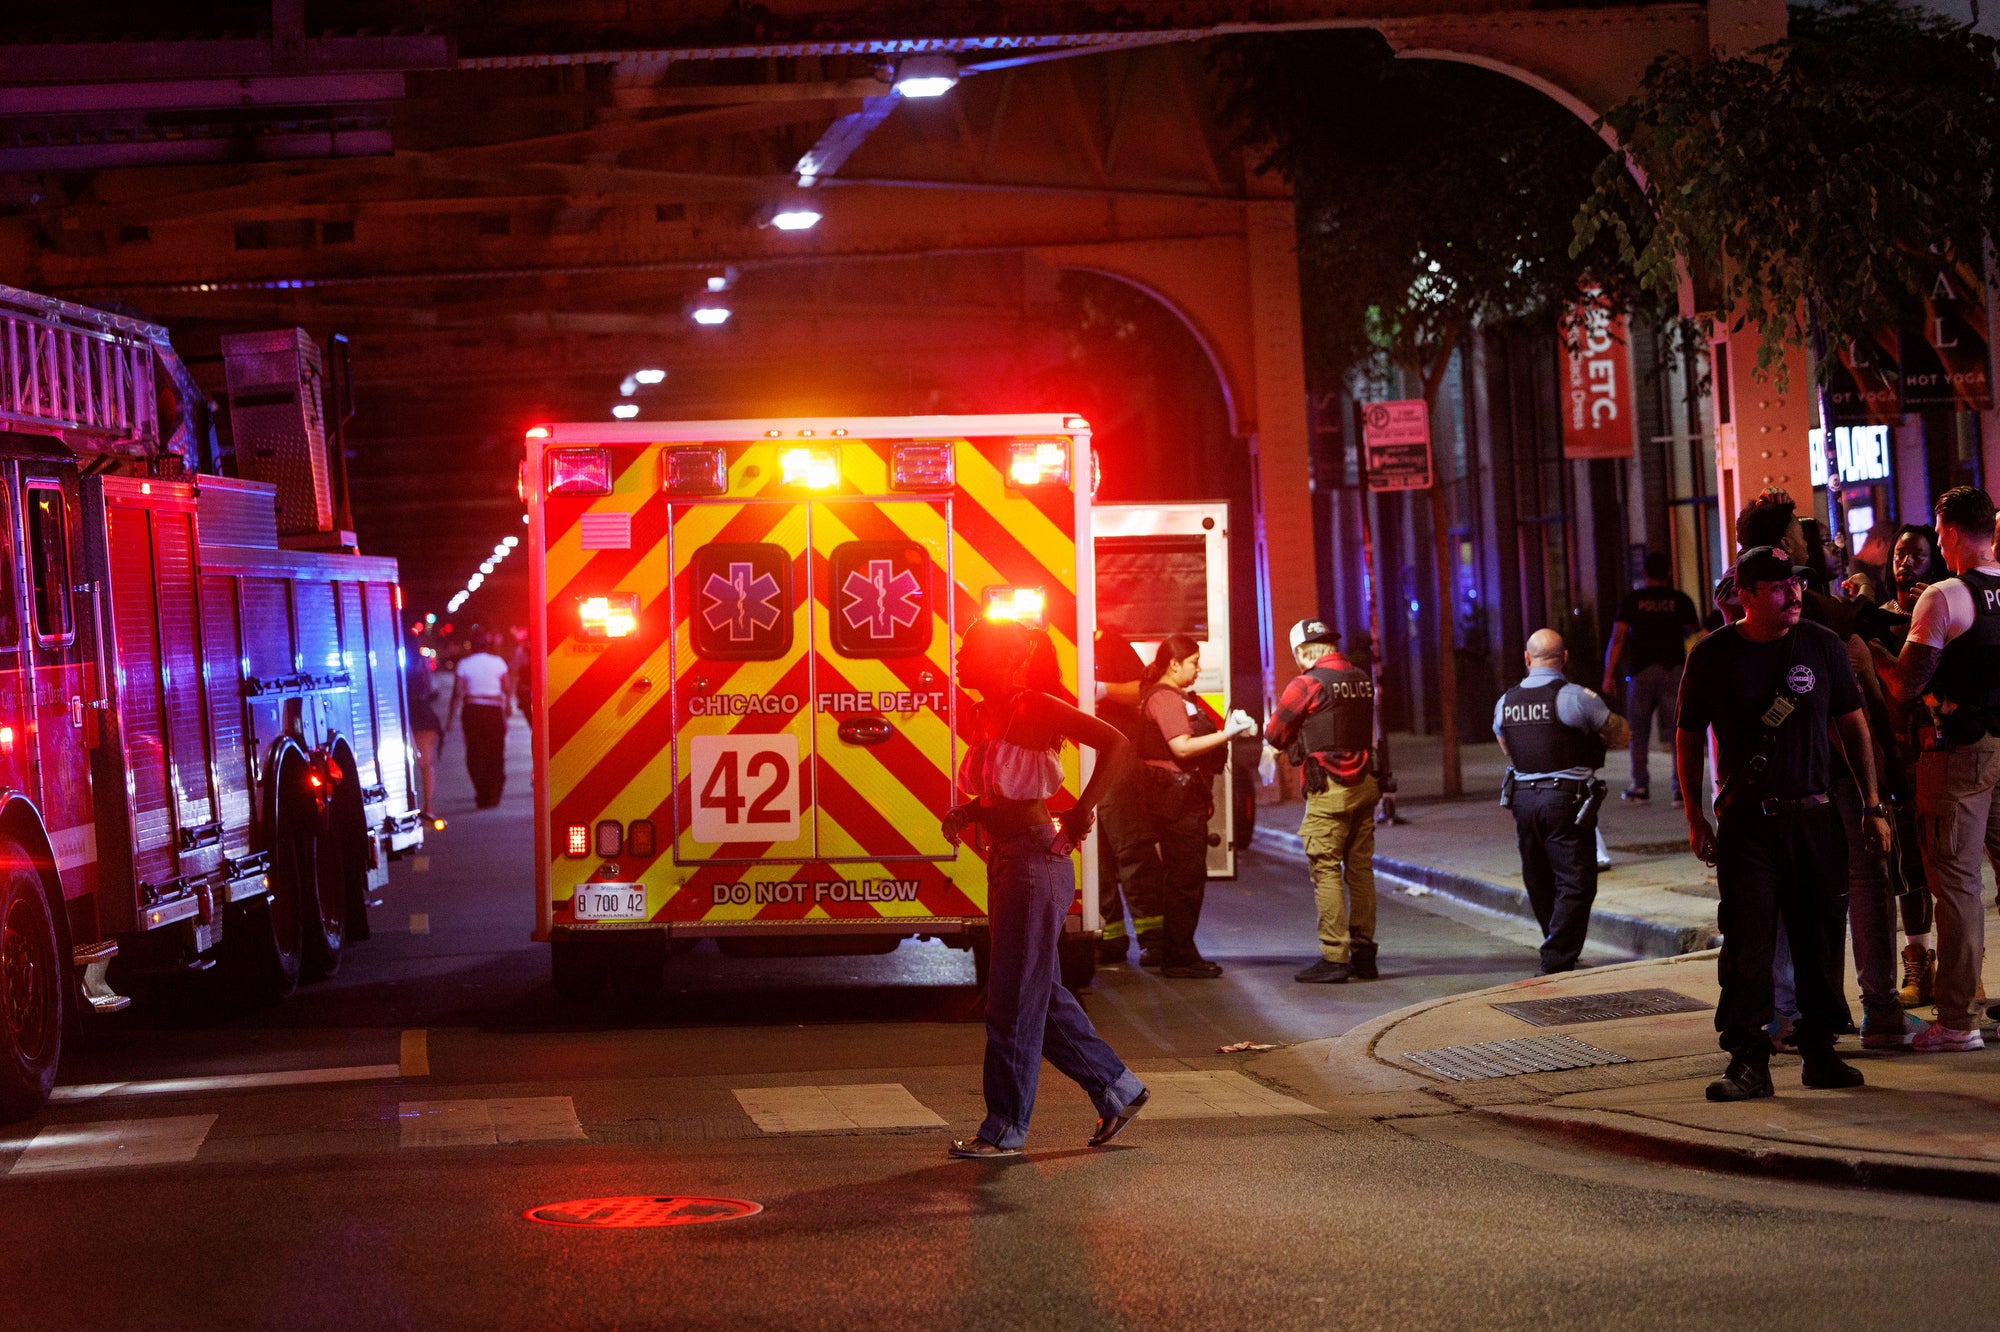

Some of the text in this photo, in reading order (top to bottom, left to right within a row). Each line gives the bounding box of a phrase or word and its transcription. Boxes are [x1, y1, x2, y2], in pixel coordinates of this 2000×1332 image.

[1906, 371, 1986, 386] HOT YOGA
[1830, 391, 1852, 404] OT
[1857, 390, 1898, 402] YOGA
[1637, 598, 1677, 613] POLICE
[572, 644, 589, 653] FDC
[1332, 681, 1374, 699] POLICE
[688, 690, 949, 716] CHICAGO FIRE DEPT.
[1504, 703, 1550, 722] POLICE
[700, 750, 791, 824] 42
[712, 878, 920, 905] DO NOT FOLLOW
[594, 894, 619, 912] 700
[627, 893, 643, 912] 42
